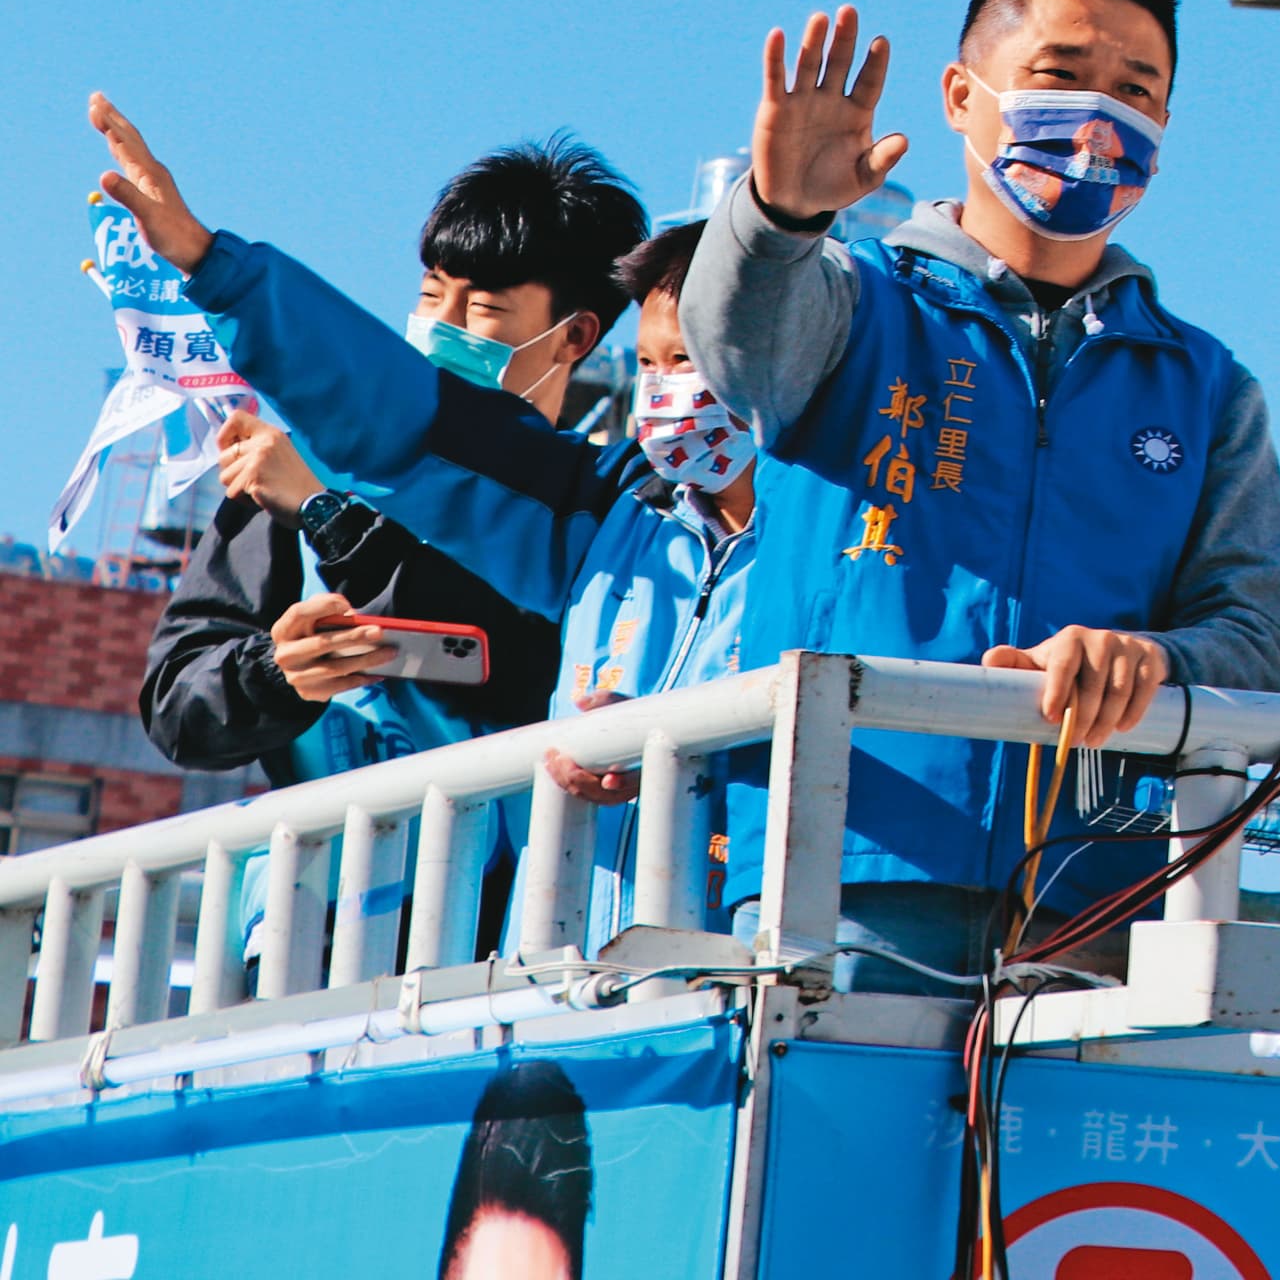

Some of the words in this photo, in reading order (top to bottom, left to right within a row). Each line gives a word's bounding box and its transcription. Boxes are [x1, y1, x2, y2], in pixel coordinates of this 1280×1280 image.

[929, 357, 977, 494] 立仁里長
[1081, 1108, 1179, 1166] 龍井
